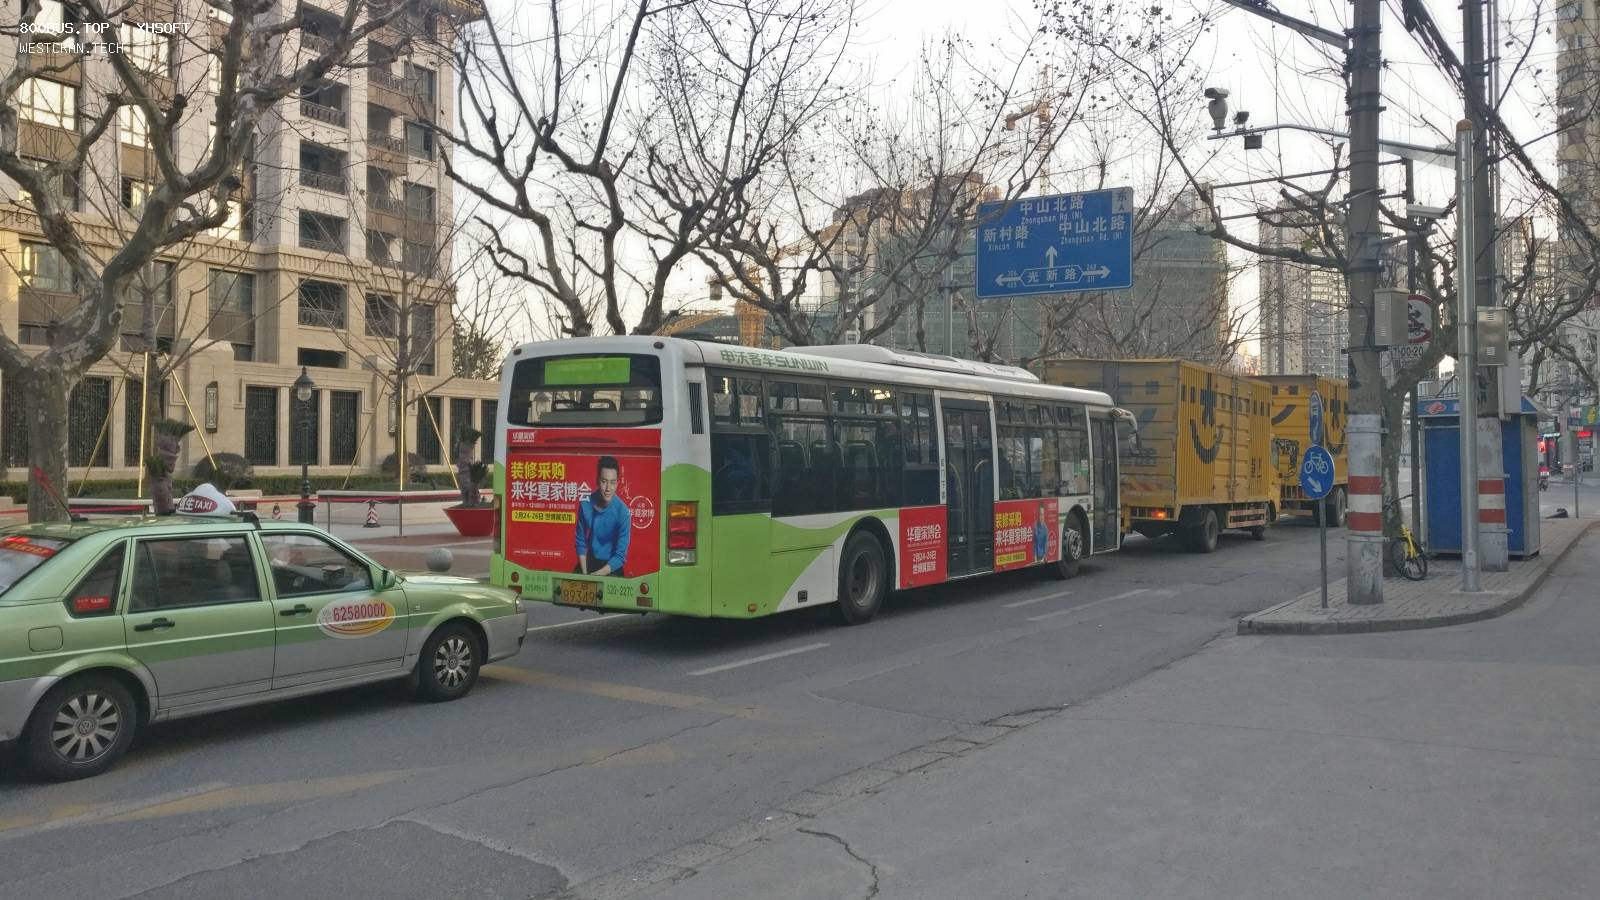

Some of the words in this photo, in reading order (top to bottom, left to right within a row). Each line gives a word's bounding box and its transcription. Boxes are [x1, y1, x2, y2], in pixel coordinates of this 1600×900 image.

[1020, 196, 1085, 215] 中山北路
[1021, 215, 1056, 226] Zhongshan
[1058, 215, 1126, 236] 中山北路
[983, 224, 1030, 243] 新村路
[1027, 270, 1077, 283] 光新路
[511, 462, 566, 480] 装修采购
[511, 480, 592, 502] 来华夏家博会
[514, 511, 544, 521] 2月24-26日
[995, 511, 1022, 528] 装修采购
[906, 524, 942, 543] 华夏家博会
[995, 526, 1034, 547] 来华夏家博会
[333, 602, 387, 622] 62580000
